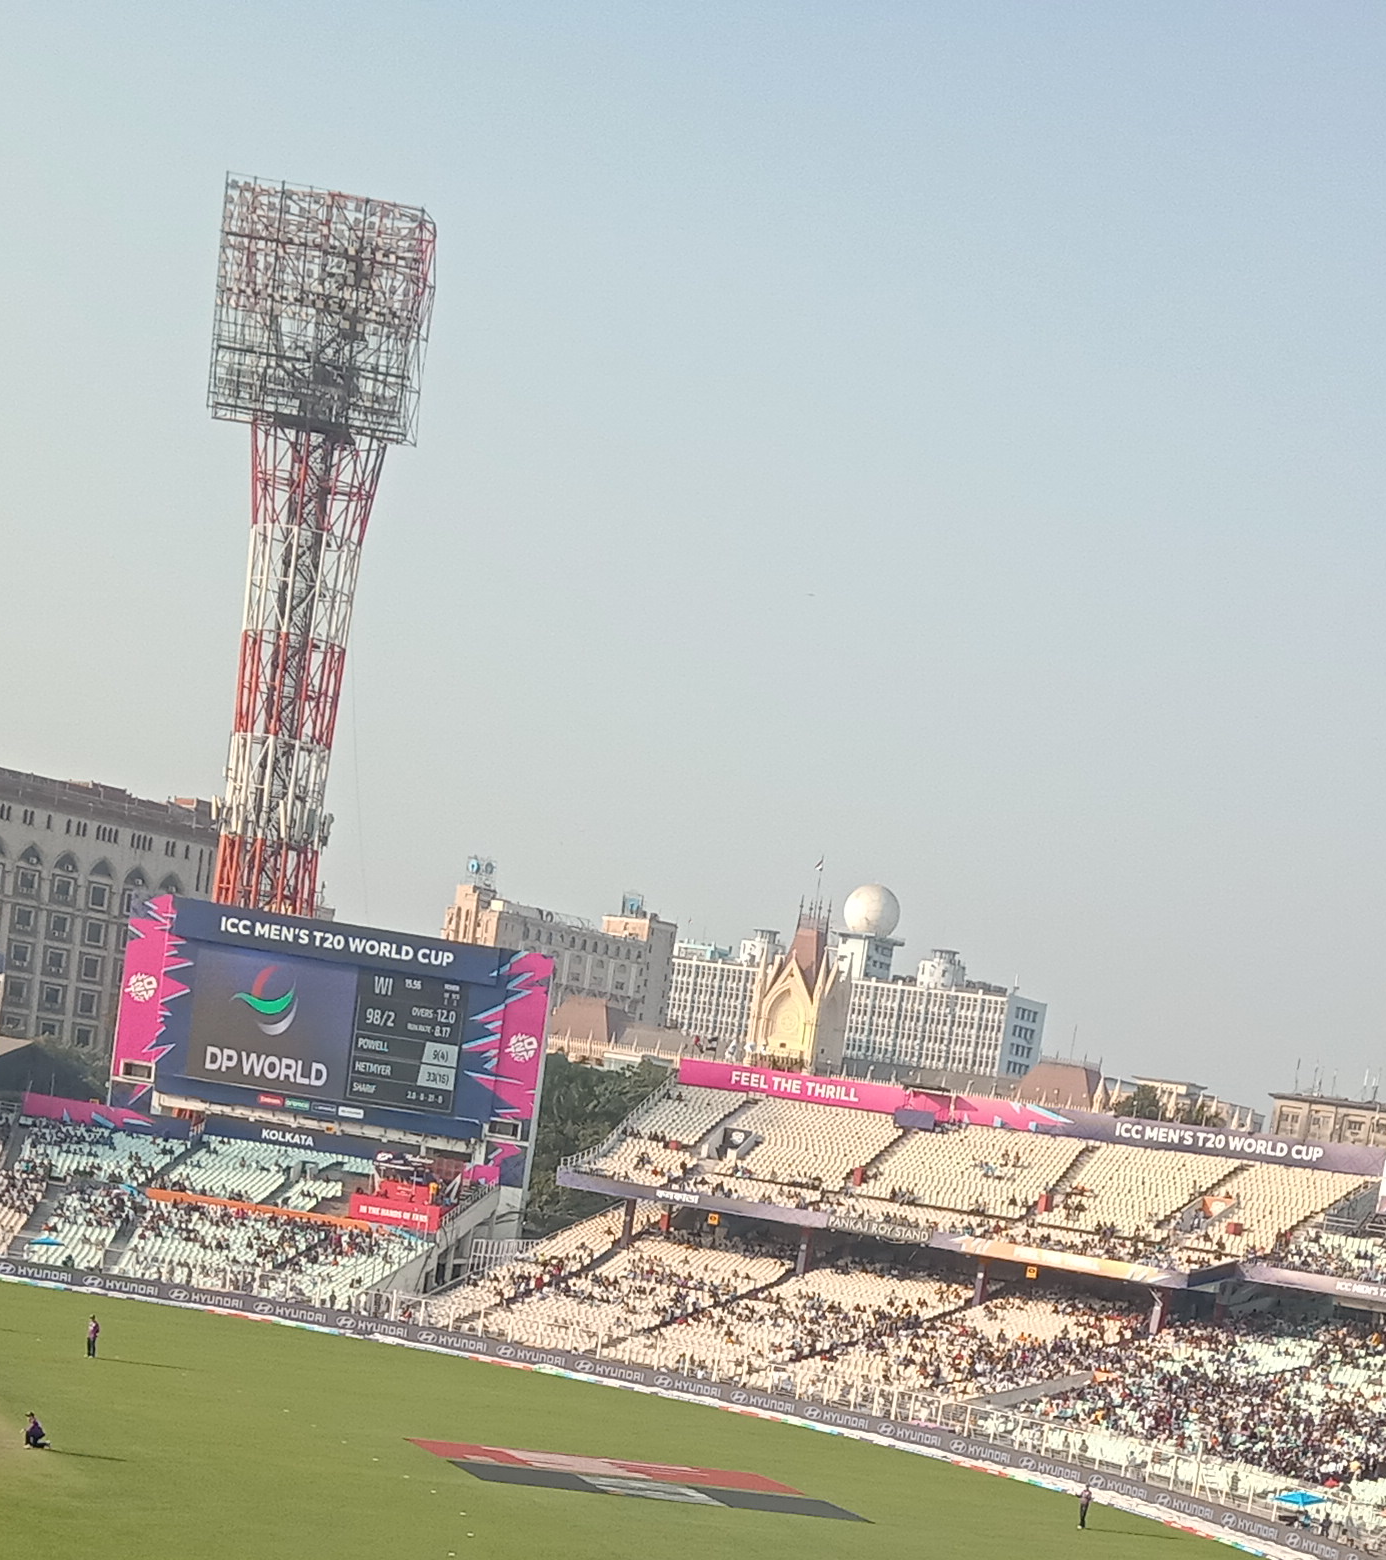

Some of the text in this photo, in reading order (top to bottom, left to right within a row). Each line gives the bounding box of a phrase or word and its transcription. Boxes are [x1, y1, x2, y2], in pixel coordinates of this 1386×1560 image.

[220, 916, 455, 967] ICC MEN'S T20 WORLD CUP
[374, 976, 393, 996] WI
[365, 1008, 395, 1027] 98/2
[412, 1007, 434, 1018] OVERS
[357, 1037, 389, 1052] POWELL
[205, 1045, 328, 1087] DP WORLD
[355, 1061, 391, 1076] HETMYER
[731, 1071, 859, 1102] FEEL THE THRILL
[261, 1128, 314, 1147] KOLKATA
[1115, 1122, 1324, 1162] ICC MEN'S T20 WORLD CUP
[828, 1217, 929, 1241] PANKAJ ROY STAND
[17, 1265, 71, 1283] HYUNDAI
[105, 1278, 158, 1296] HYUNDAI
[1336, 1281, 1353, 1292] ICC
[191, 1292, 243, 1309] HYUNDAI
[275, 1305, 326, 1323] HYUNDAI
[357, 1320, 407, 1337] HYUNDAI
[438, 1335, 487, 1352] HYUNDAI
[516, 1348, 566, 1366] HYUNDAI
[595, 1364, 644, 1382] HYUNDAI
[674, 1379, 721, 1397] HYUNDAI
[749, 1395, 795, 1413] HYUNDAI
[822, 1411, 868, 1429] HYUNDAI
[897, 1427, 941, 1446] HYUNDAI
[967, 1444, 1010, 1463] HYUNDAI
[1038, 1462, 1081, 1481] HYUNDAI
[1107, 1480, 1148, 1500] HYUNDAI
[1172, 1499, 1213, 1520] HYUNDAI
[1237, 1518, 1278, 1540] HYUNDAI
[1302, 1540, 1339, 1560] HYUNDAI
